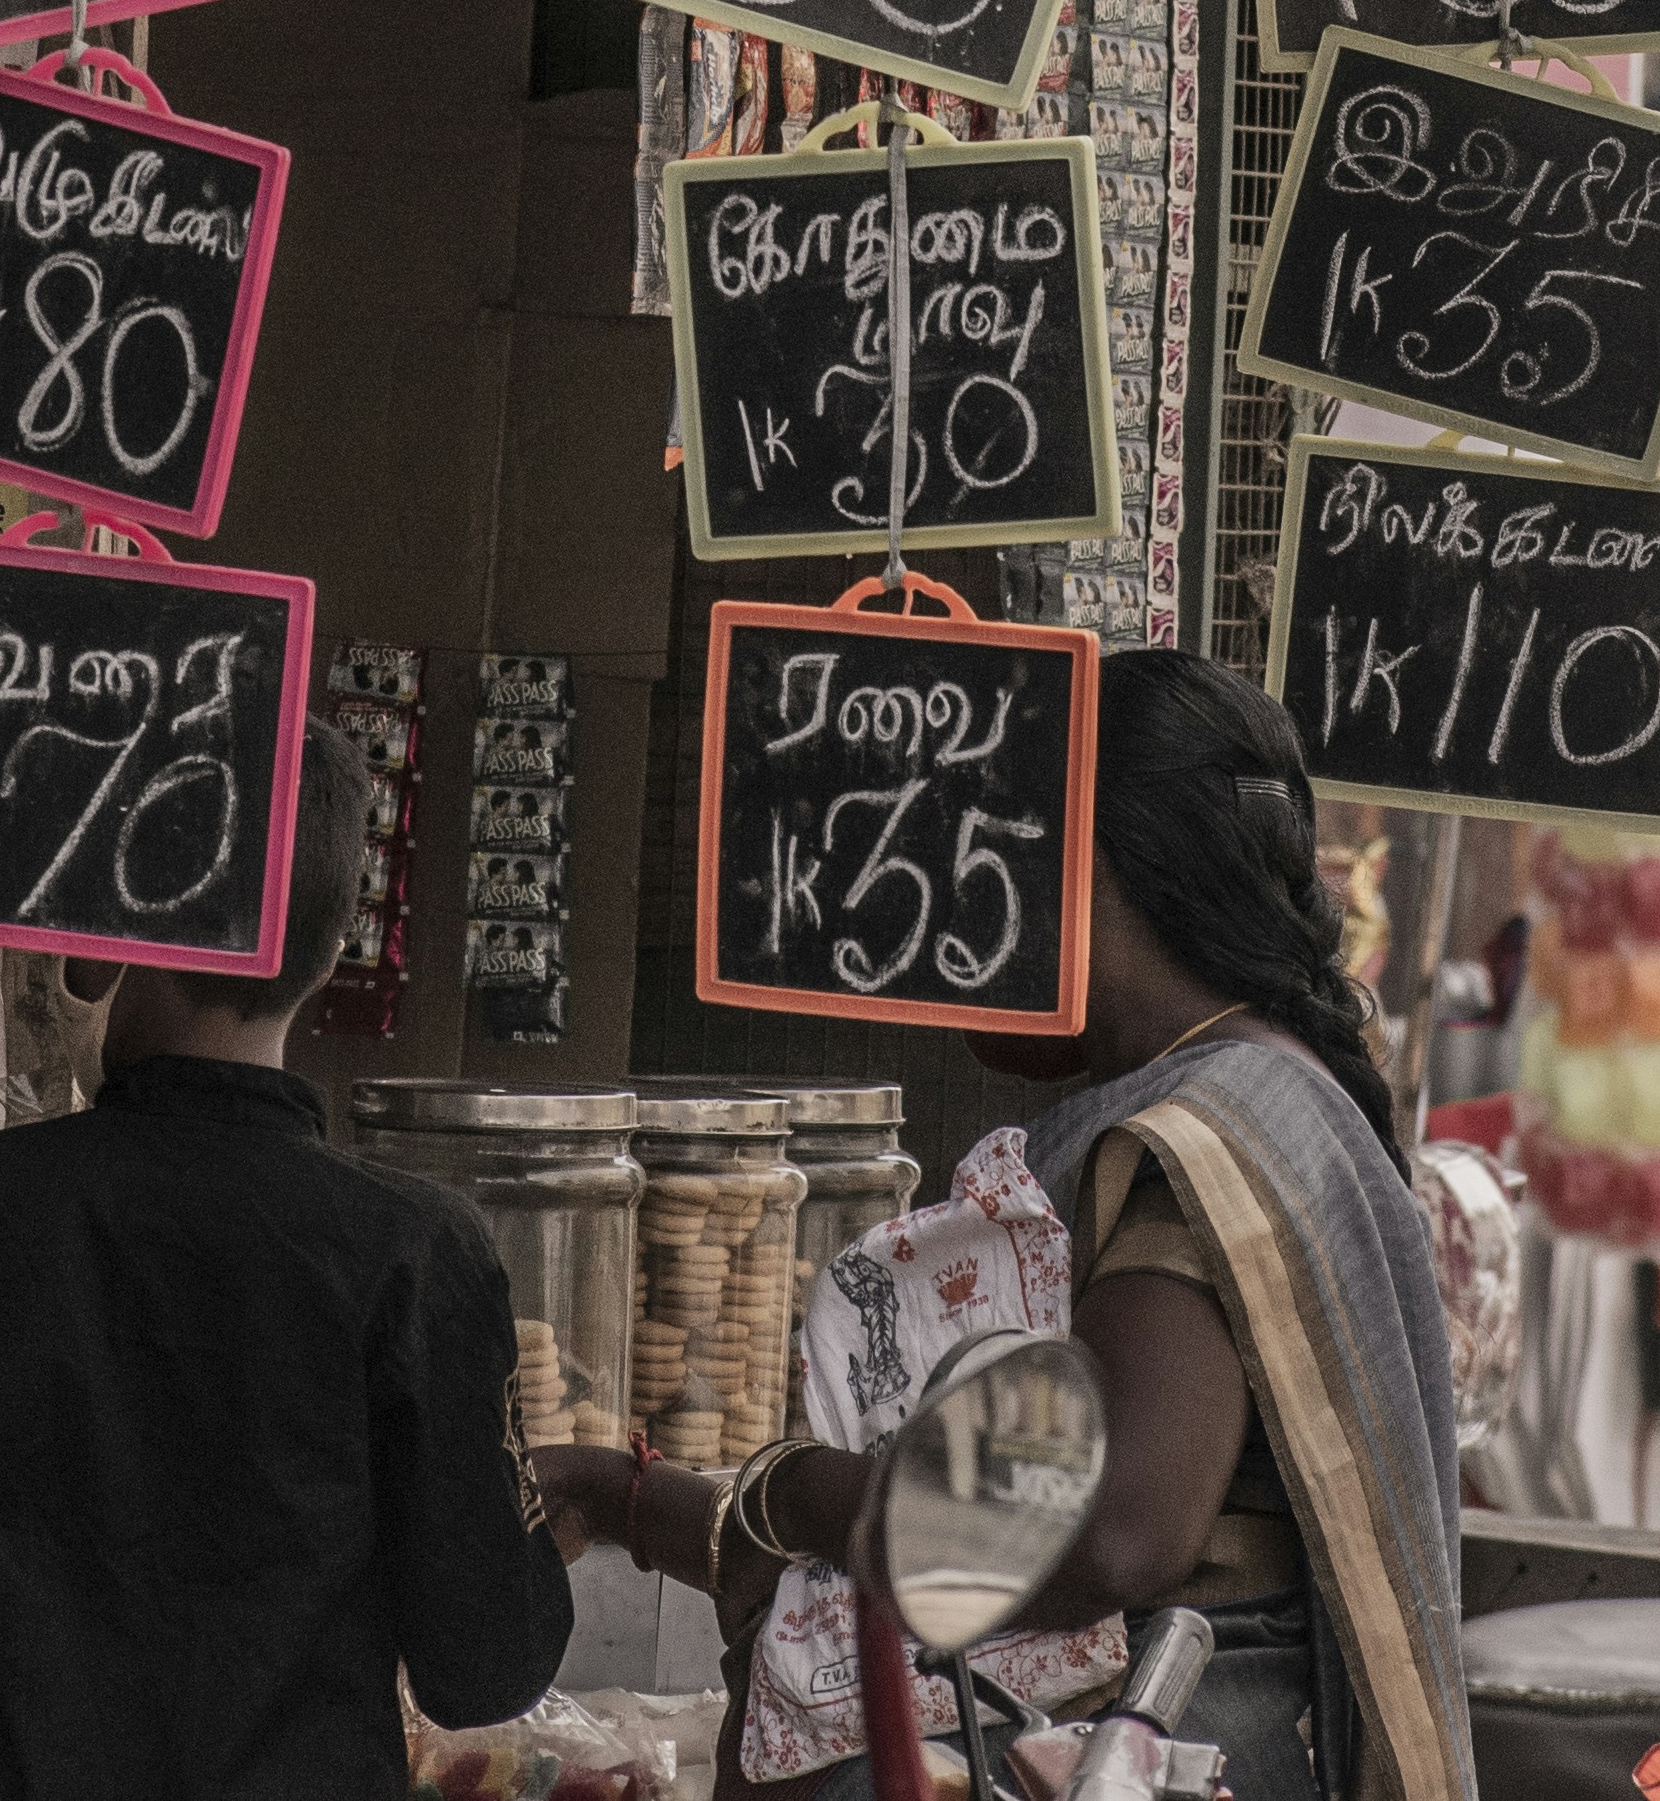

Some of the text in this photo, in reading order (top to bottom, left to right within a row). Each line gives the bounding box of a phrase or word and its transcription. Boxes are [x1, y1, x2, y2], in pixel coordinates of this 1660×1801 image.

[17, 250, 212, 475] 80
[1397, 231, 1646, 407] 35
[816, 364, 1039, 525] 30
[764, 652, 1013, 768] ரவை
[2, 723, 236, 916] 70
[824, 778, 1045, 992] 35
